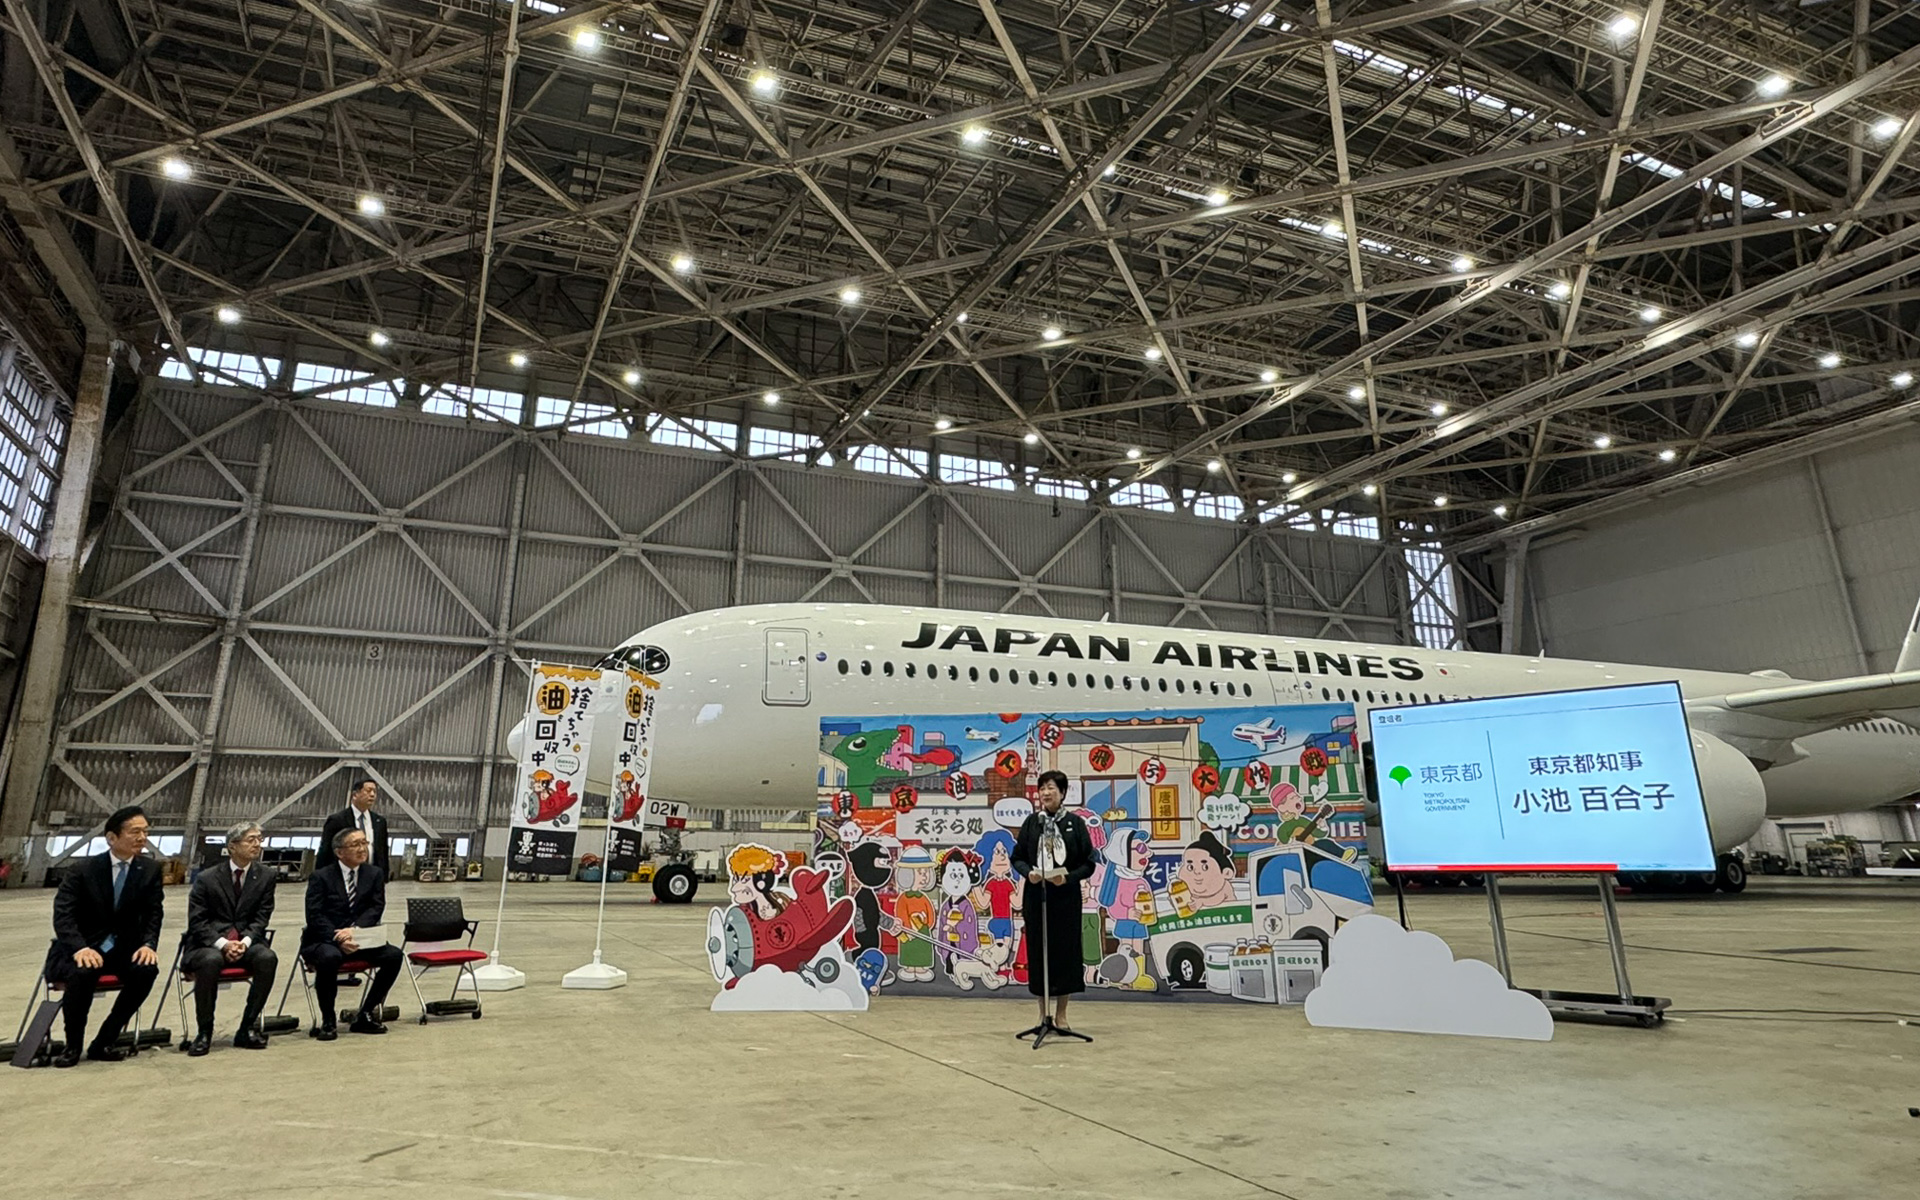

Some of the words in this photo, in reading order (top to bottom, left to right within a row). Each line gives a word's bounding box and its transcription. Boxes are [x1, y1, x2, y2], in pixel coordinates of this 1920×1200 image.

[370, 645, 380, 659] 3
[901, 622, 1130, 662] JAPAN
[1152, 640, 1425, 681] AIRLINES
[1420, 762, 1483, 784] 東京都
[1528, 750, 1643, 776] 東京都知事
[1513, 786, 1571, 814] 小池
[1578, 783, 1675, 812] 百合子
